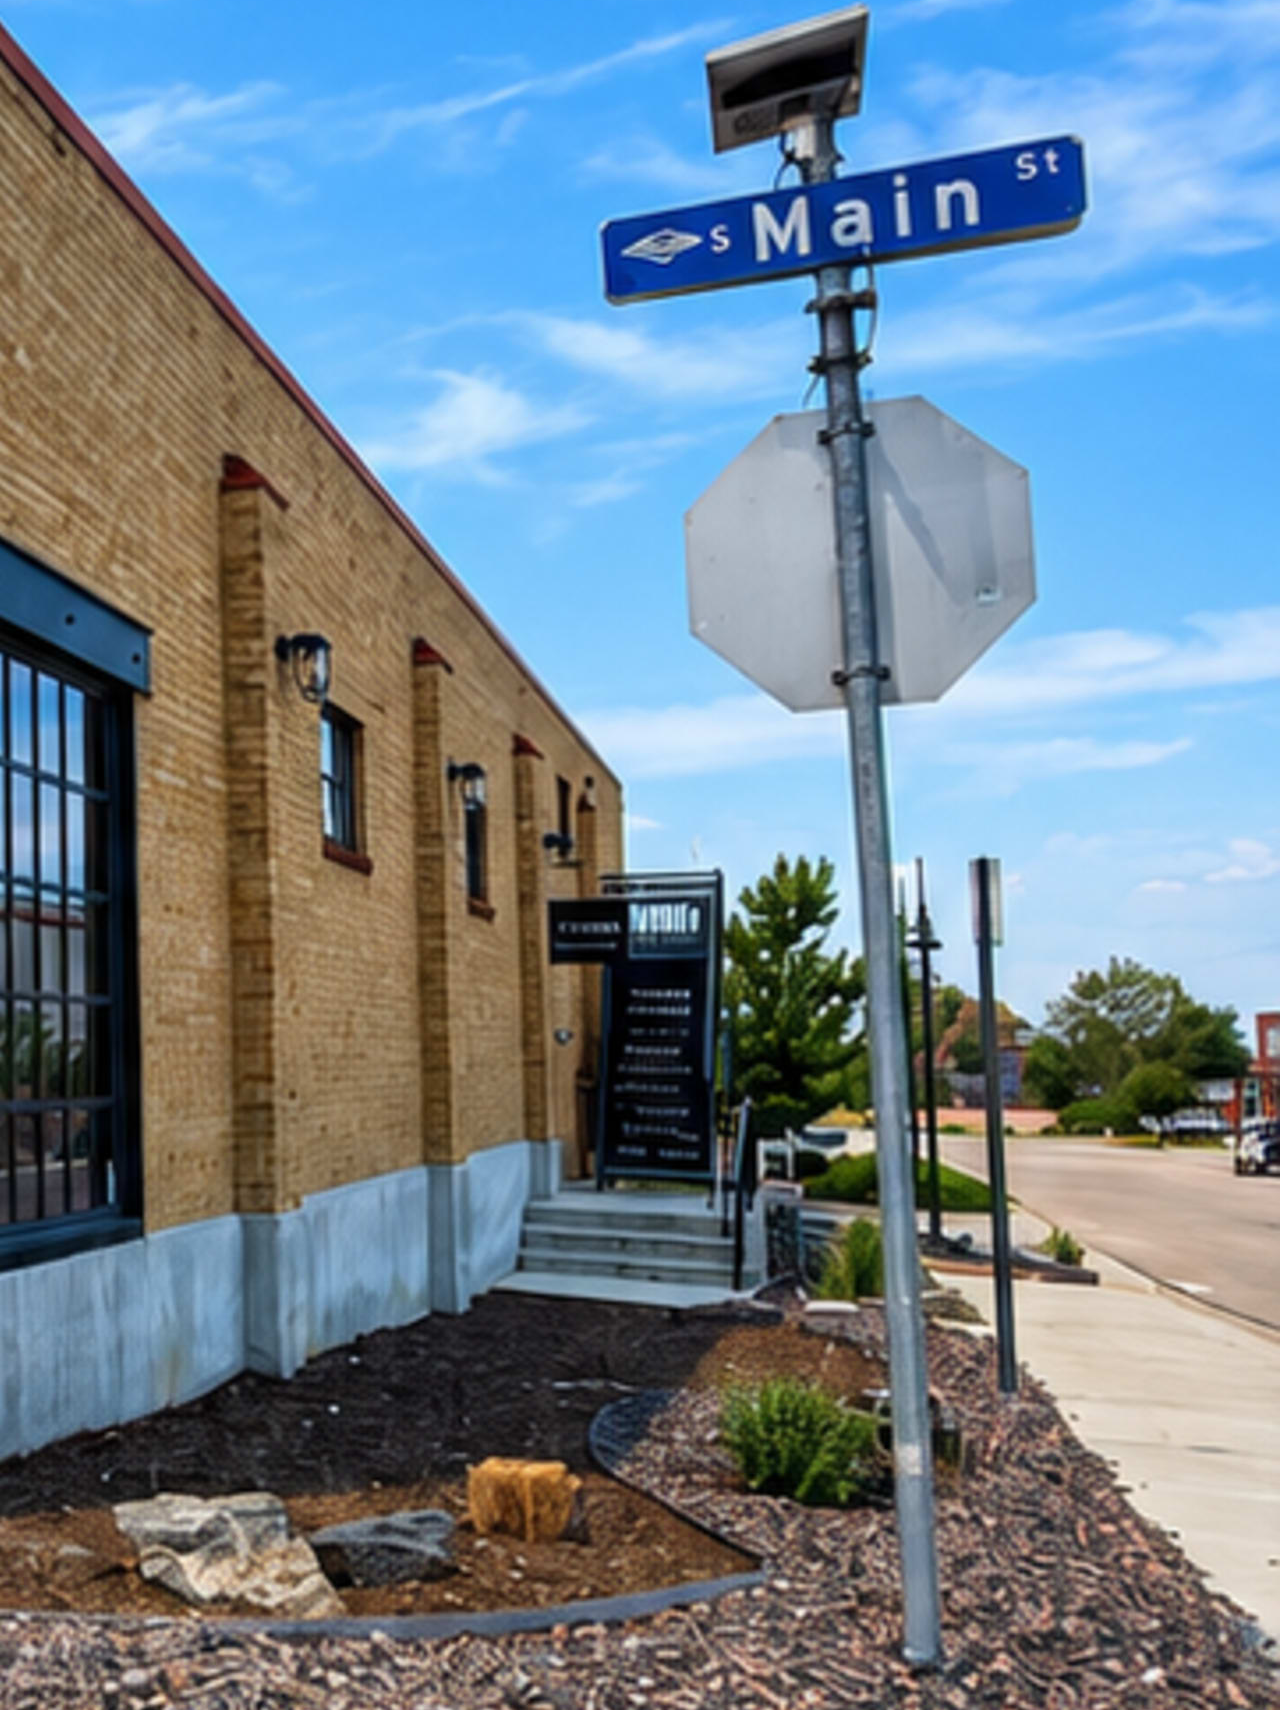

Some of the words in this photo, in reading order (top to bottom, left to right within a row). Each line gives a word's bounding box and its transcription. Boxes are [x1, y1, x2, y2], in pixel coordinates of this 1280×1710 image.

[709, 224, 731, 254] S
[752, 174, 980, 263] Main
[1015, 148, 1060, 180] St
